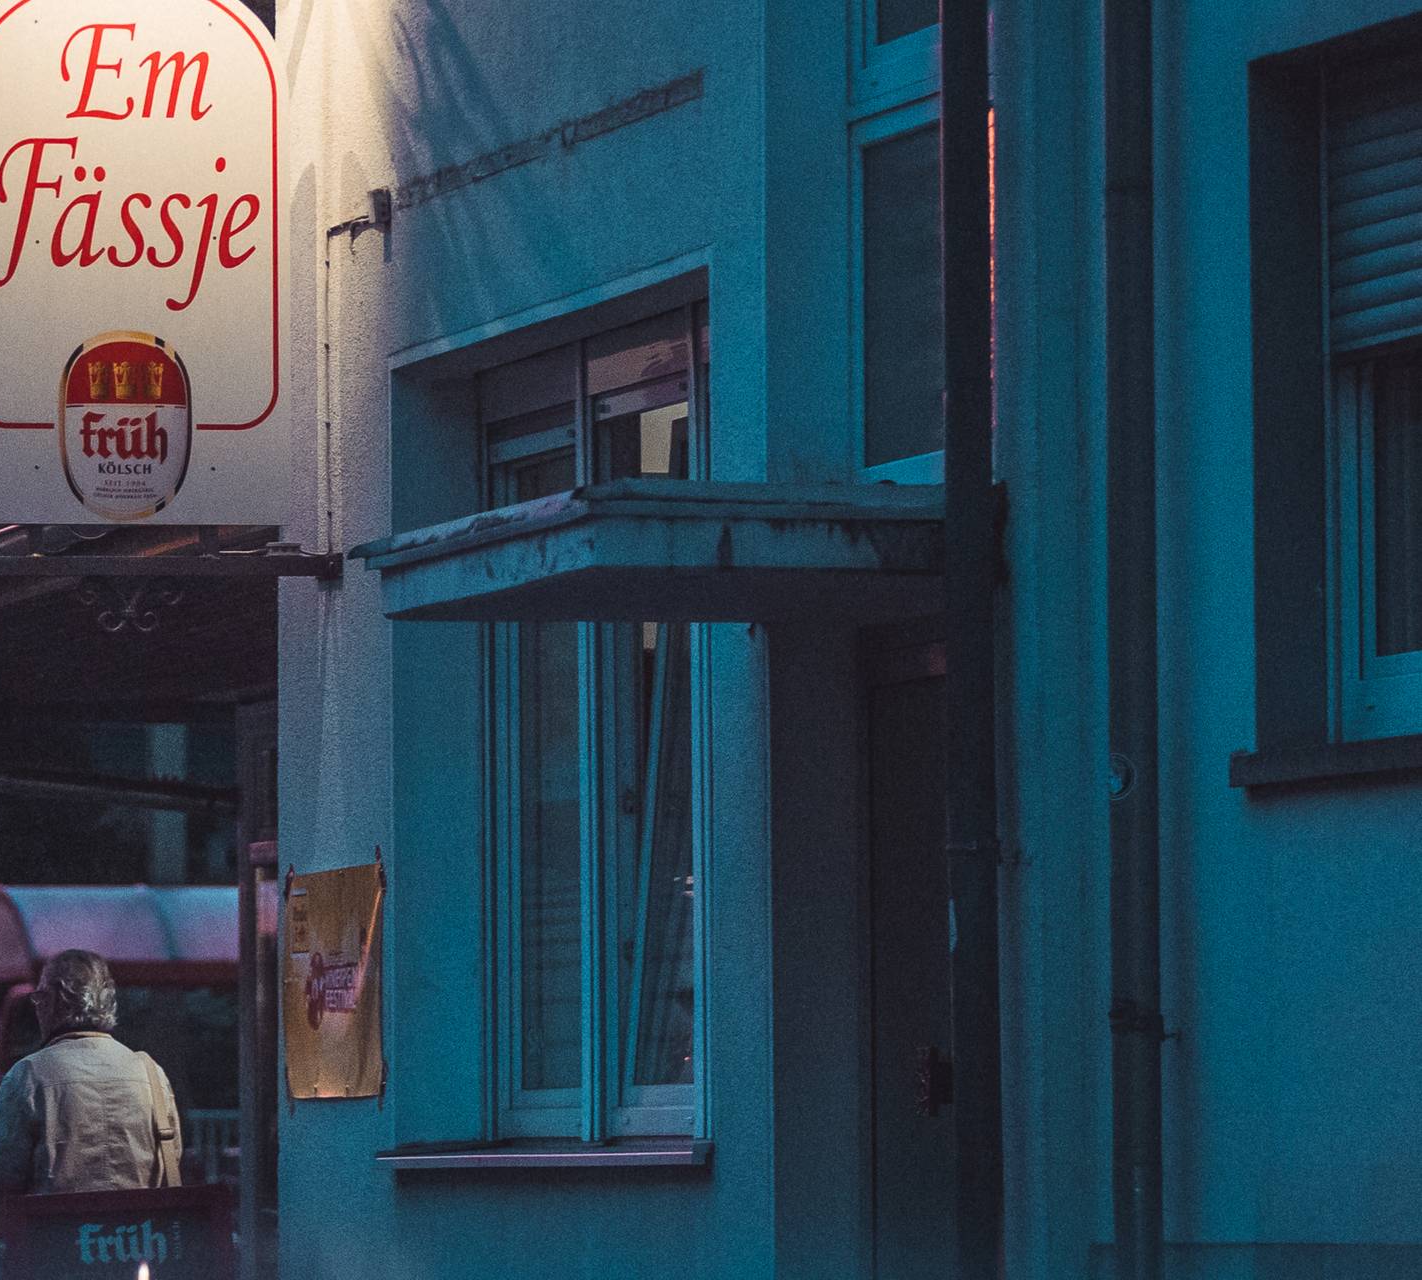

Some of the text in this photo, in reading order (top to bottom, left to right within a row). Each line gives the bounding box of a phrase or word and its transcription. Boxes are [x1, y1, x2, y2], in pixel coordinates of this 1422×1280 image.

[60, 23, 213, 121] Em
[80, 411, 168, 464] früh
[98, 461, 152, 475] KÖLSCH
[76, 1219, 168, 1264] früh
